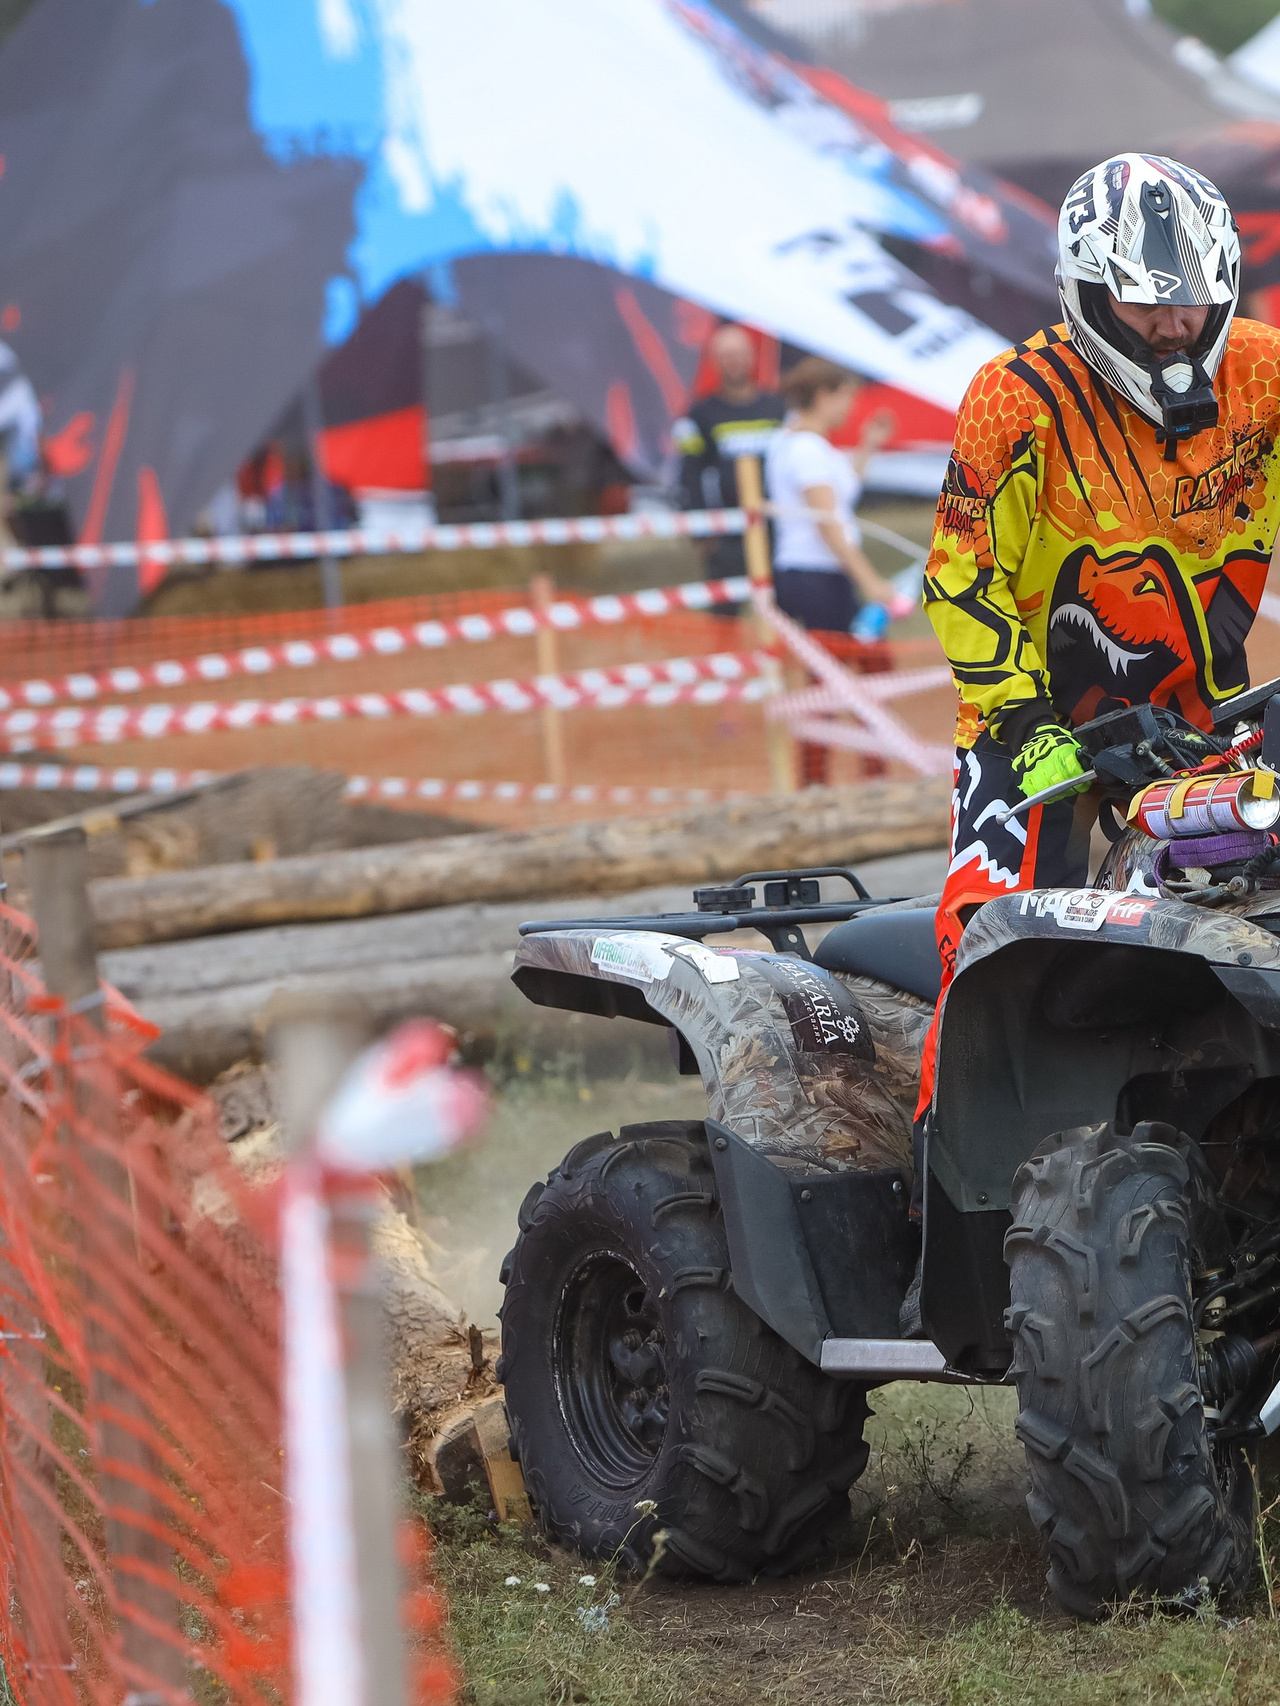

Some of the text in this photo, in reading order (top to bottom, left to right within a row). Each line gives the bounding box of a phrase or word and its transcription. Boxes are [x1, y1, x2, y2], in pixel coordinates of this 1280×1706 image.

[1066, 171, 1097, 235] 073
[943, 506, 974, 531] URAL
[776, 961, 839, 1045] BAVARIA
